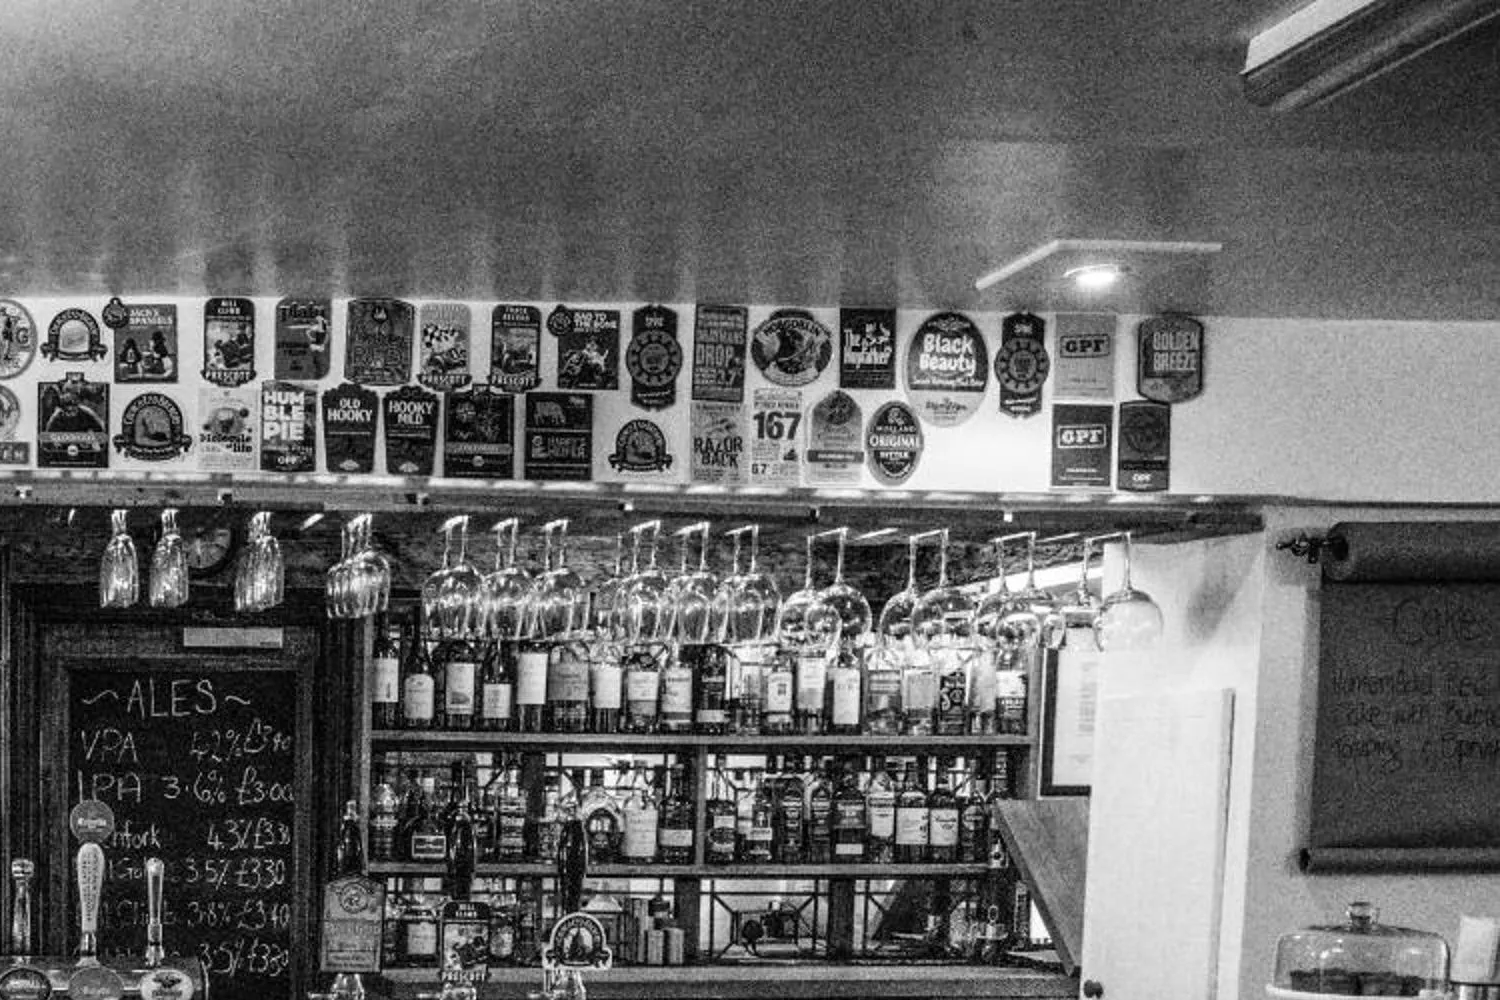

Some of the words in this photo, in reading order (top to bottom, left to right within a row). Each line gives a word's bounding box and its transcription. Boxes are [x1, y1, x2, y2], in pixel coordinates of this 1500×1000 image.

[924, 333, 973, 354] Black
[1153, 331, 1198, 350] GOLDEN
[920, 353, 975, 376] Beauty
[1153, 352, 1197, 371] BREEZE
[263, 391, 304, 404] HUM
[339, 397, 360, 409] OLD
[388, 400, 434, 414] HOOKY
[263, 405, 304, 421] BLE
[327, 408, 373, 422] HOOKY
[263, 422, 304, 441] PIE
[752, 411, 803, 441] 167
[693, 436, 743, 454] RAZOR
[126, 677, 217, 720] ALES
[78, 769, 141, 803] IPA
